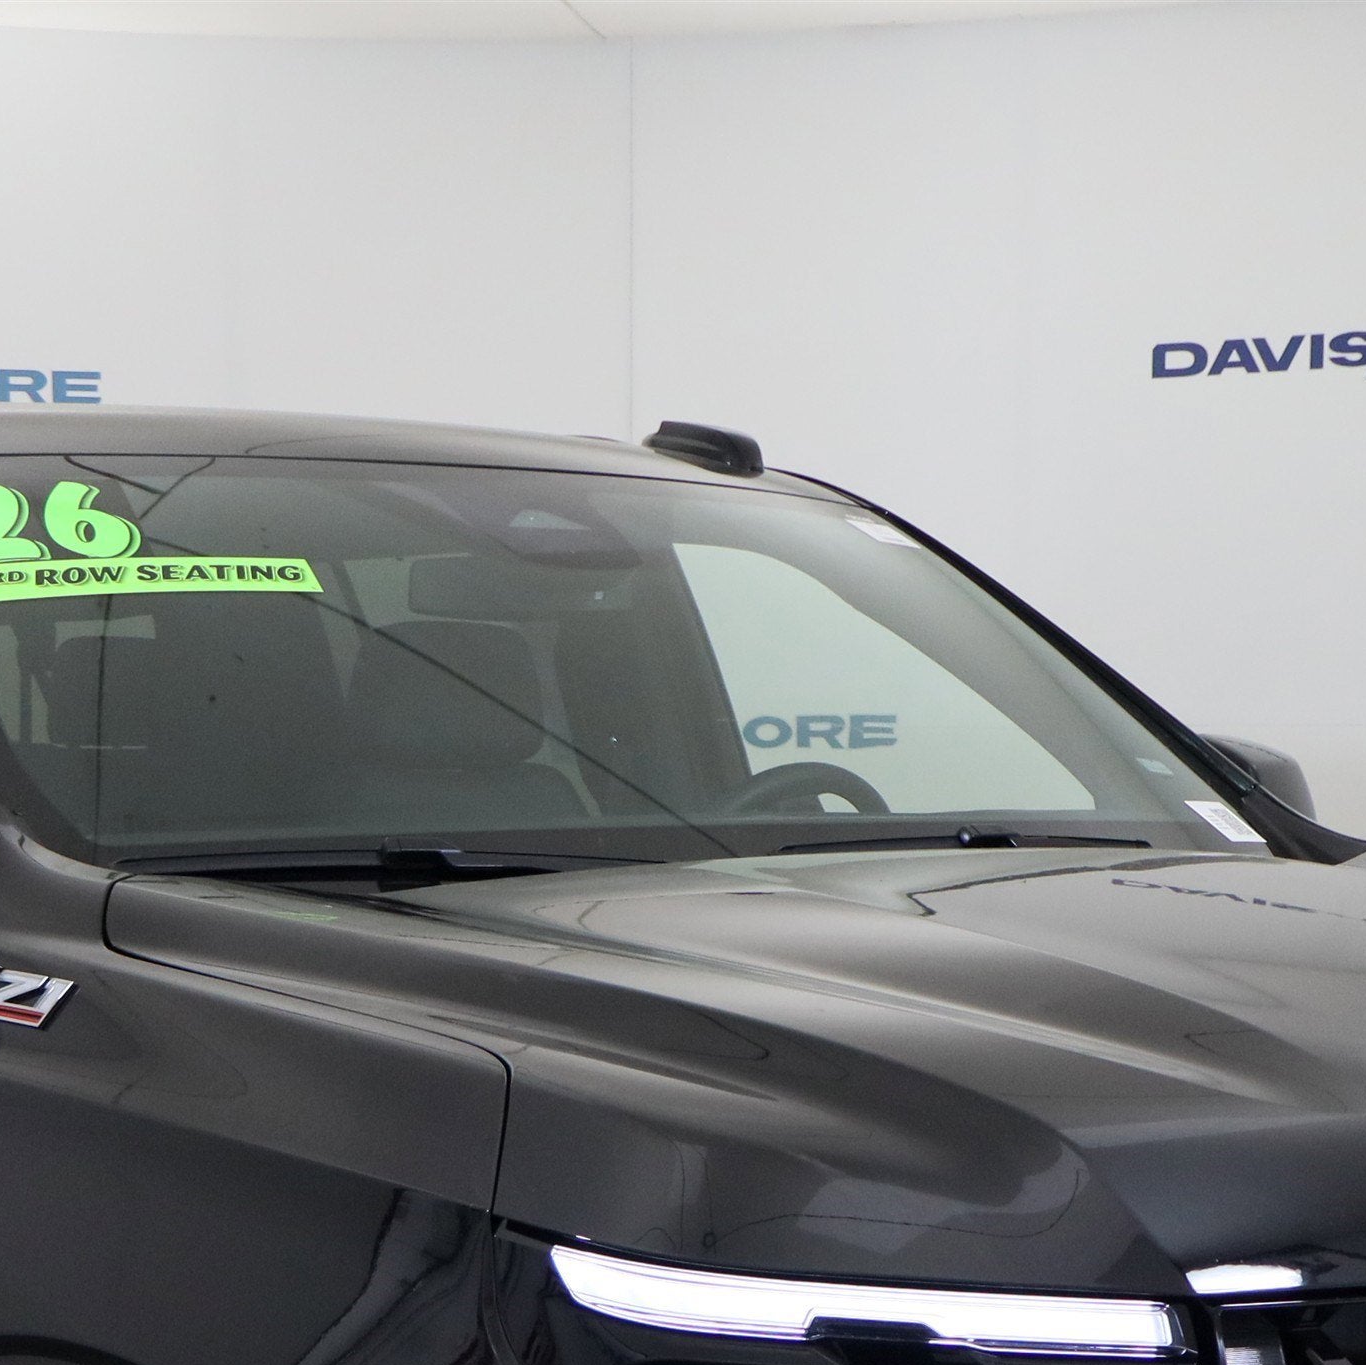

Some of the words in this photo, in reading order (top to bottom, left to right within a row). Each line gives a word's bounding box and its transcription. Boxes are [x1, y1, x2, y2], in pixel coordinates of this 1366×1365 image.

[34, 565, 124, 587] ROW
[136, 563, 305, 583] SEATING
[742, 714, 898, 750] ORE
